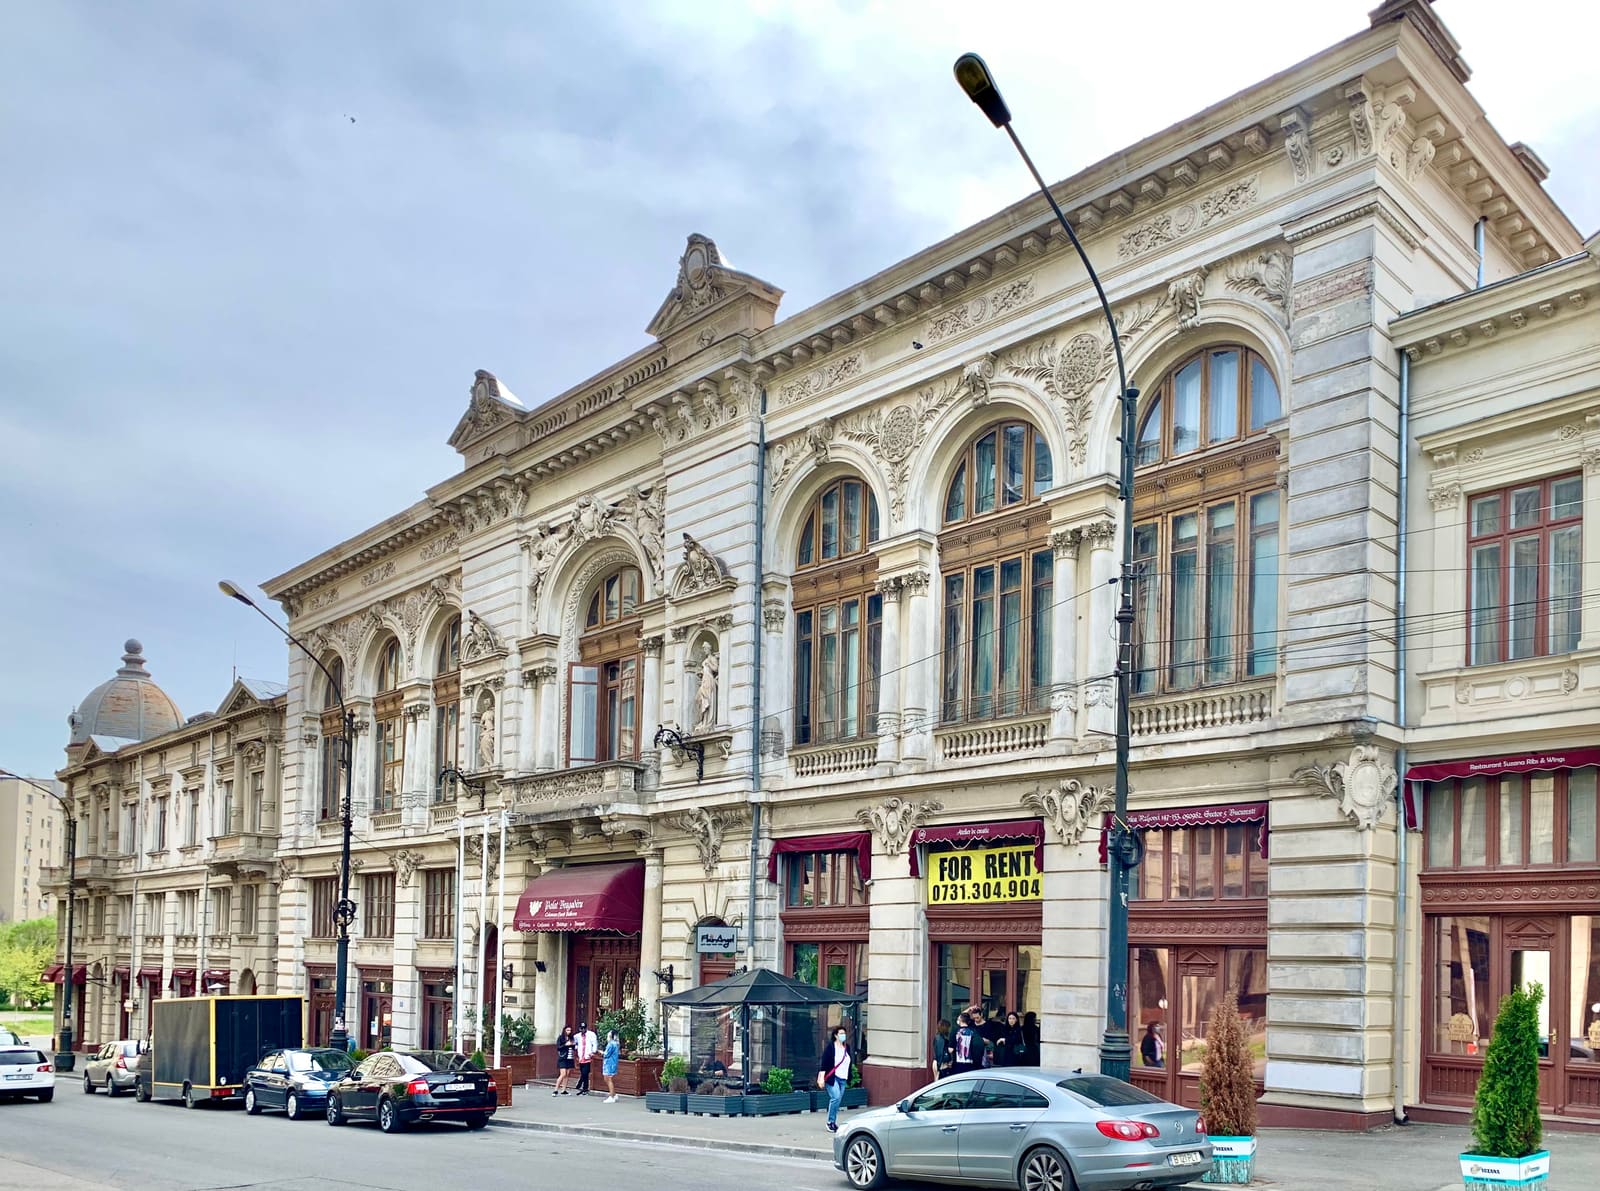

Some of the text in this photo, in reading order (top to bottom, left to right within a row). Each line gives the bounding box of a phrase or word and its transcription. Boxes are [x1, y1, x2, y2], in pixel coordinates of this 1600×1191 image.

[1469, 761, 1502, 770] Restaurant
[1546, 756, 1566, 764] Wings
[939, 850, 1034, 882] FOR RENT
[932, 879, 1040, 902] 0731.304.904
